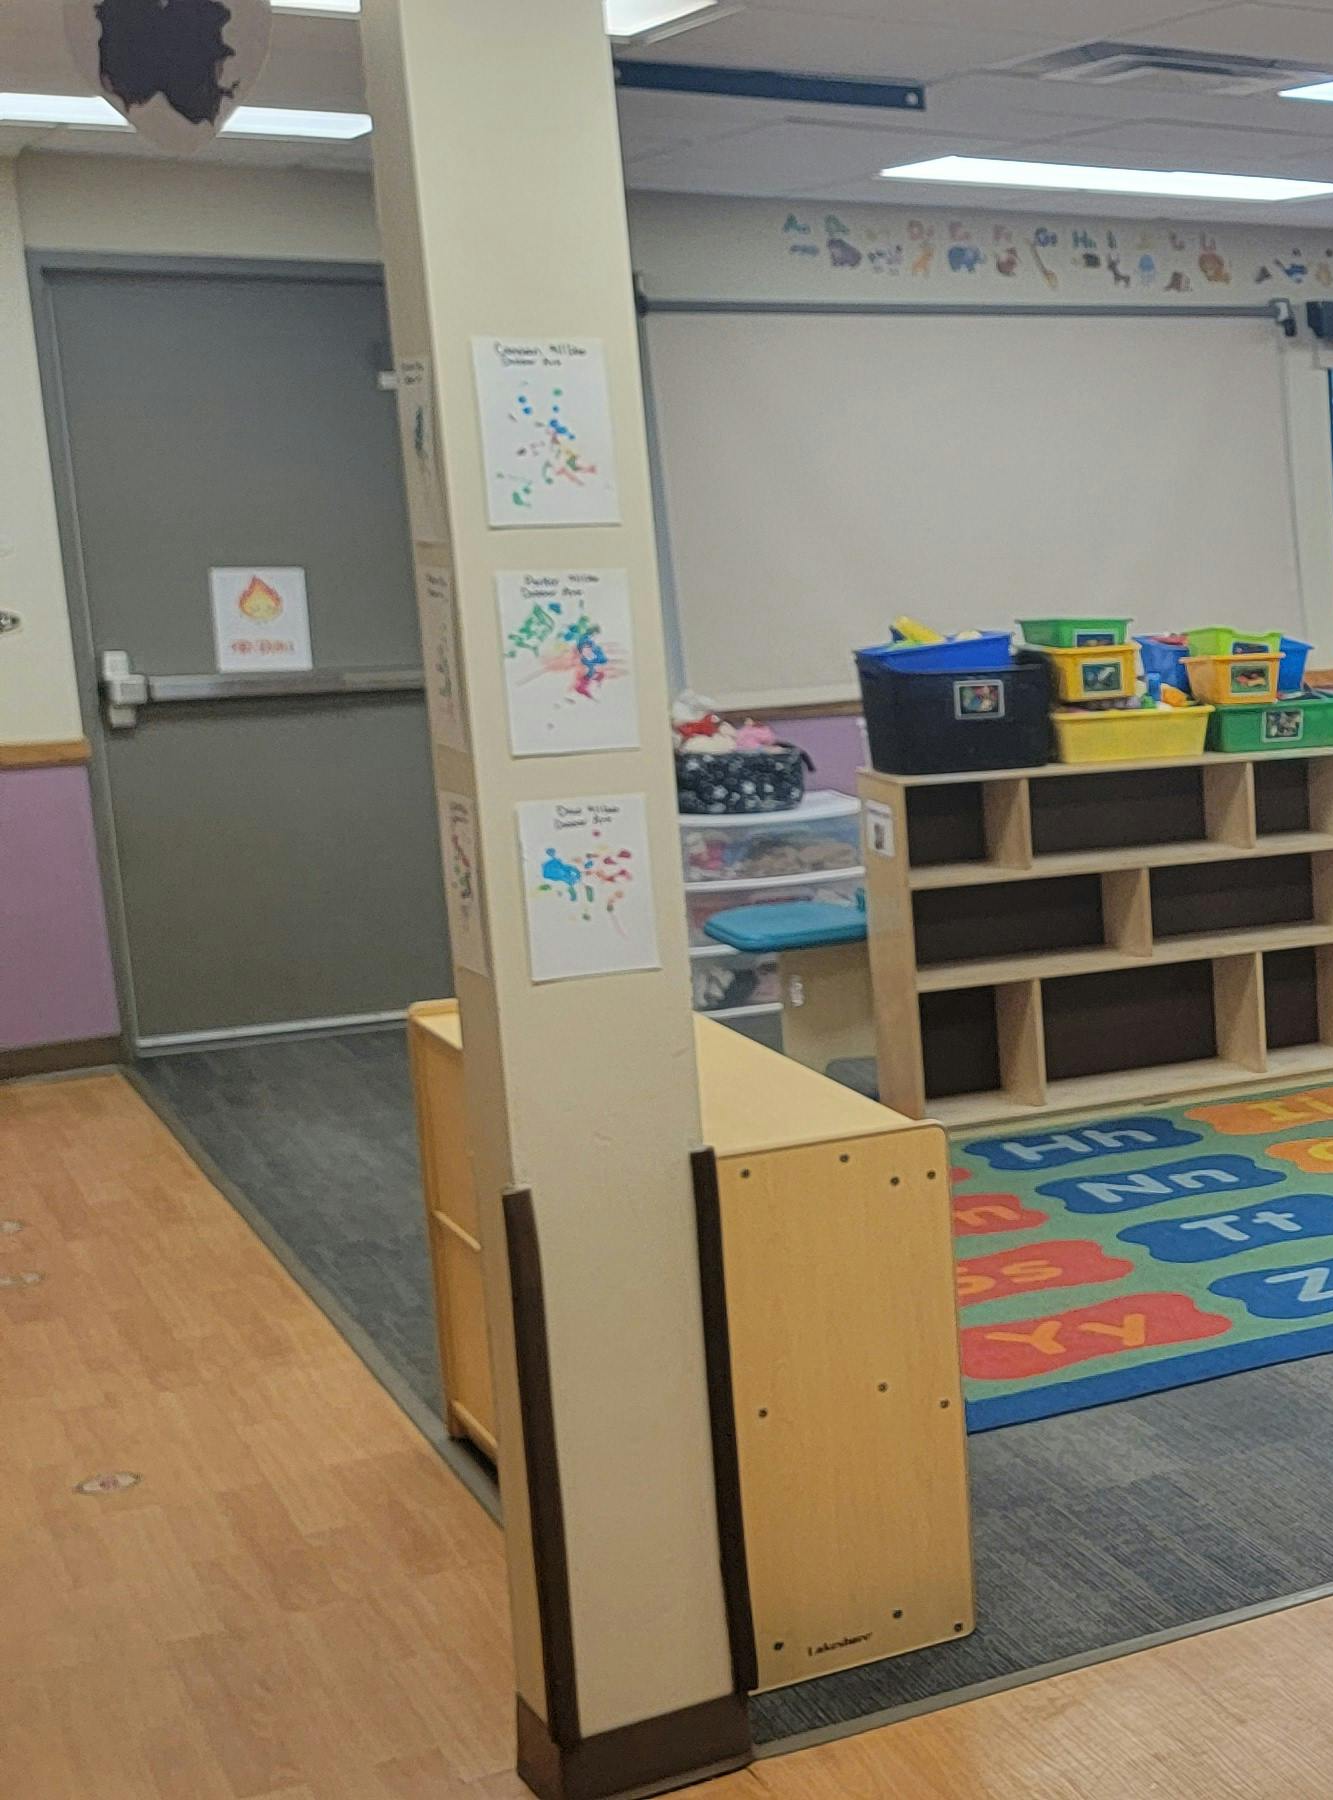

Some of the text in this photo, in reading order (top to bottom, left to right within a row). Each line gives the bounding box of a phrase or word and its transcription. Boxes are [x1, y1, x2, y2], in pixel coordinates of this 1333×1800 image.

[1003, 1116, 1159, 1163] Hh
[1077, 1167, 1240, 1204] Nn
[1180, 1210, 1303, 1243] Tt
[985, 1313, 1146, 1354] Yy
[808, 1631, 873, 1657] Lakeshore
